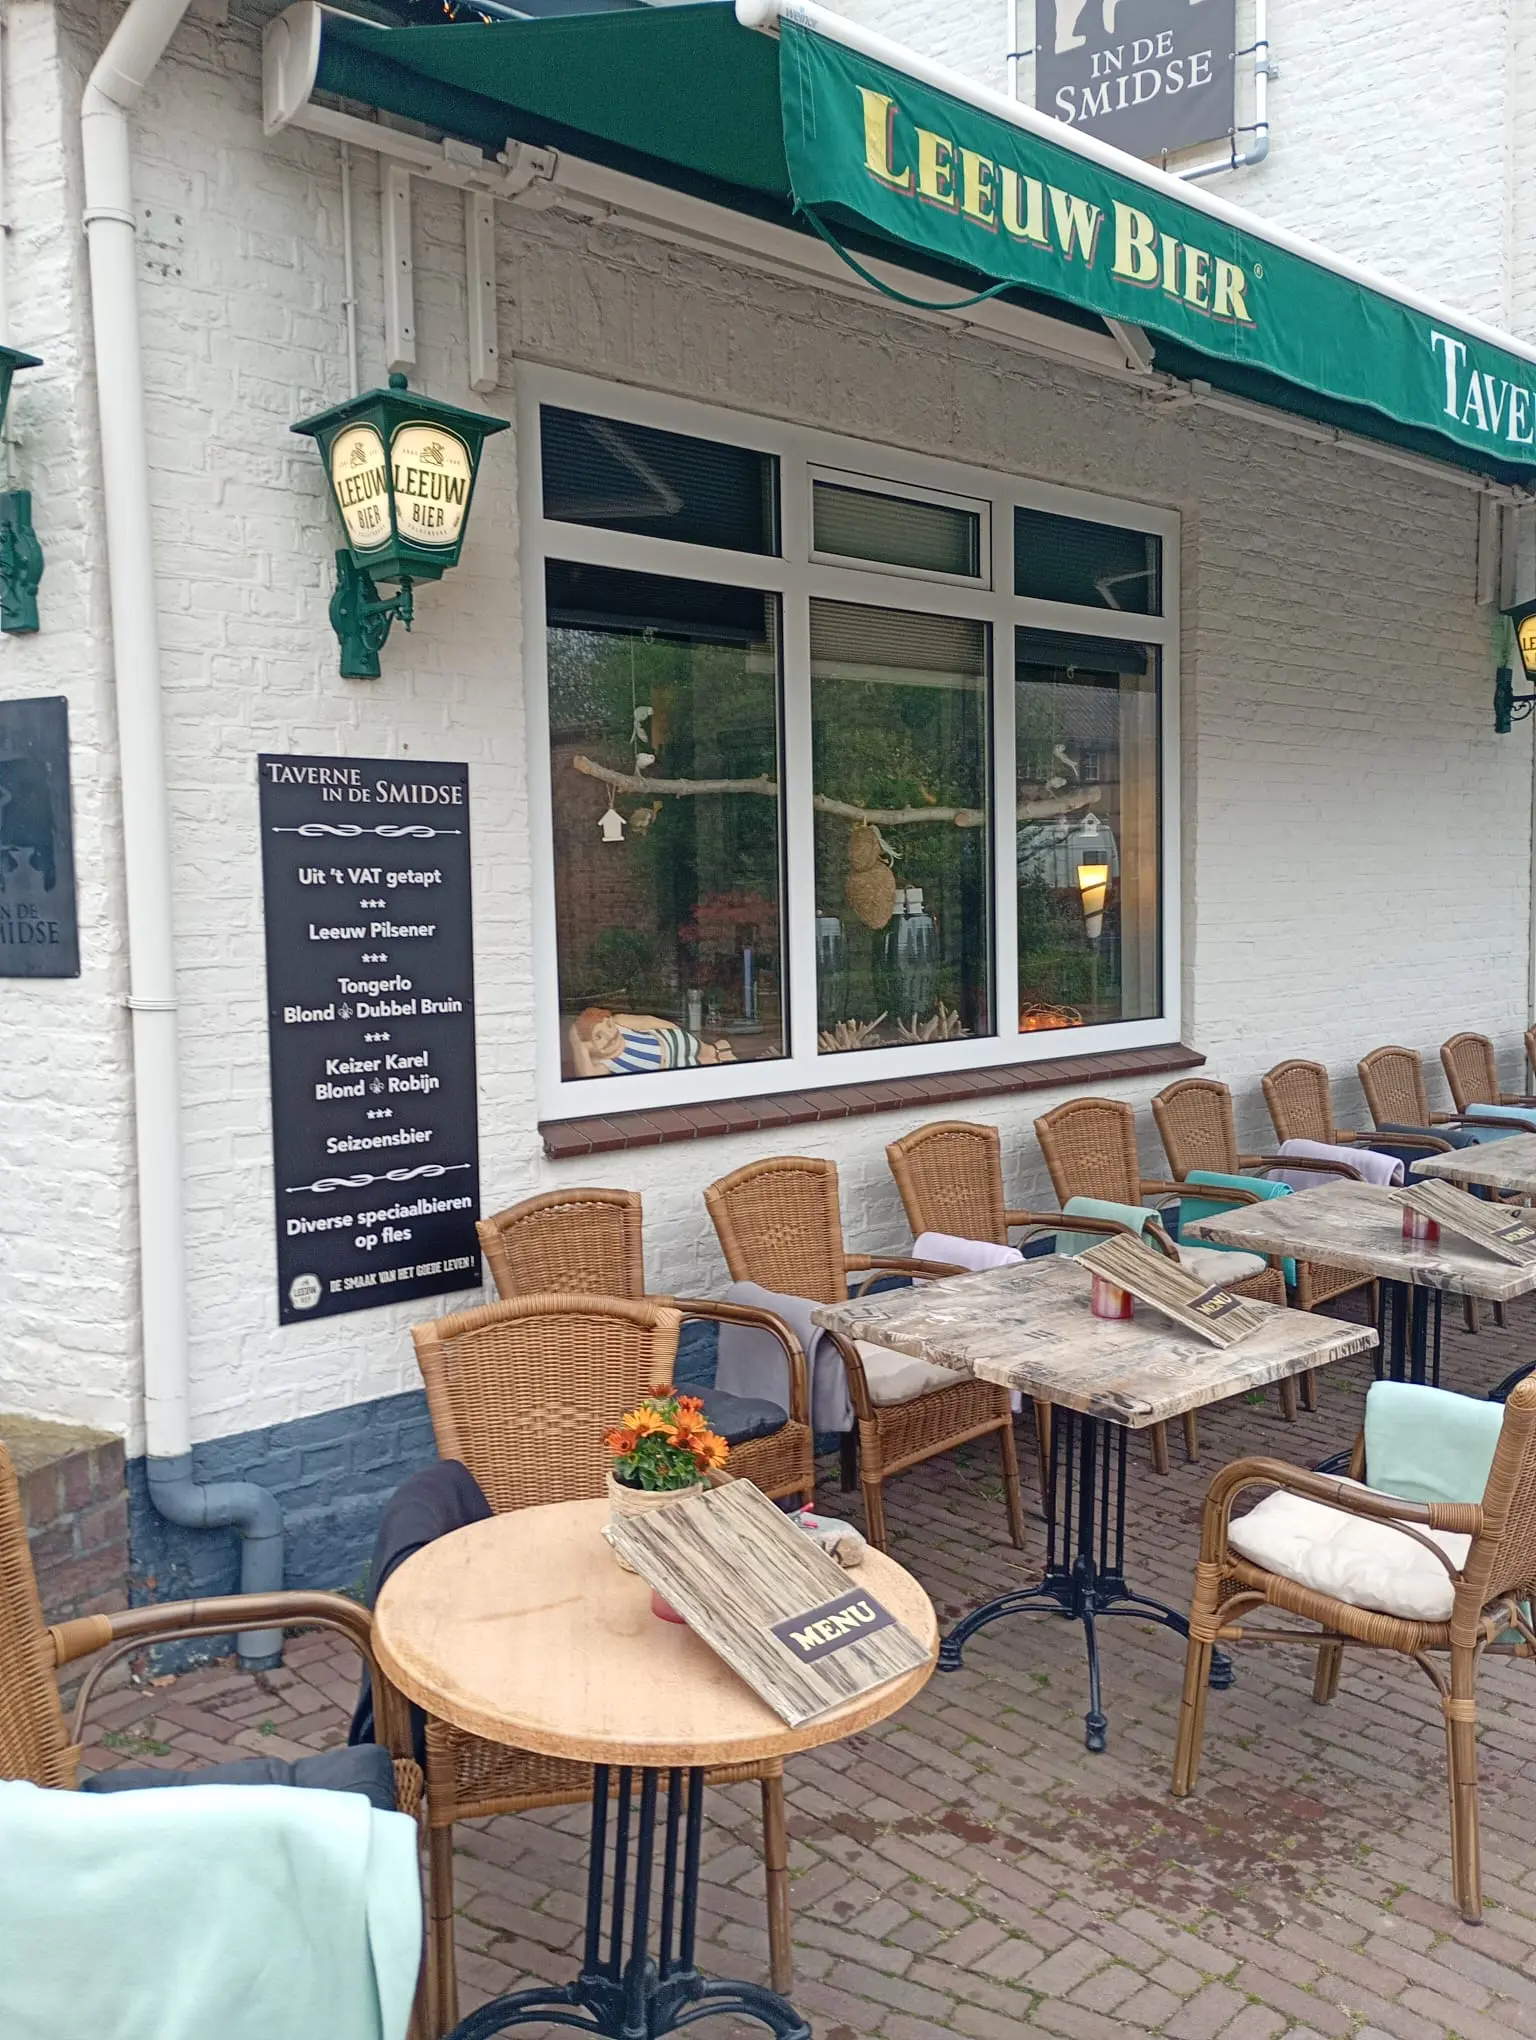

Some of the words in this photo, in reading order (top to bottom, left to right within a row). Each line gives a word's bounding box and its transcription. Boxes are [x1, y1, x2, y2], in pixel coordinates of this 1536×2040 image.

[1091, 45, 1125, 78] IN
[1132, 30, 1174, 65] DE
[1055, 50, 1212, 123] SMIDSE
[855, 84, 1105, 270] LEEUW
[1110, 199, 1257, 329] BIER
[1430, 329, 1536, 444] TAVE
[337, 465, 387, 508] LEEUW
[394, 464, 466, 506] LEEUW
[357, 504, 382, 529] BIER
[412, 503, 444, 527] BIER
[266, 763, 361, 786] TAVERNE
[322, 787, 342, 801] IN
[348, 788, 371, 803] DE
[375, 780, 463, 804] SMIDSE
[298, 867, 326, 884] Uit
[348, 868, 382, 884] VAT
[385, 869, 442, 888] getapt
[309, 923, 366, 940] Leeuw
[370, 921, 436, 938] Pilsener
[337, 974, 412, 996] Tongerlo
[284, 1004, 335, 1023] Blond
[356, 999, 416, 1019] Dubbel
[421, 997, 462, 1014] Bruin
[325, 1058, 381, 1076] Keizer
[385, 1050, 429, 1070] Karel
[315, 1079, 365, 1101] Blond
[388, 1074, 440, 1094] Robijn
[326, 1128, 433, 1154] Seizoensbier
[286, 1213, 353, 1236] Diverse
[357, 1196, 472, 1227] speciaalbieren
[354, 1233, 378, 1251] op
[382, 1226, 412, 1244] fles
[1500, 1226, 1536, 1242] MENU
[329, 1279, 343, 1293] DE
[343, 1272, 378, 1292] SMAAK
[378, 1269, 397, 1284] VAN
[397, 1264, 414, 1280] HET
[415, 1260, 443, 1277] GOEDE
[443, 1256, 470, 1272] LEVEN
[1196, 1291, 1232, 1317] MENU
[789, 1600, 877, 1651] MENU
